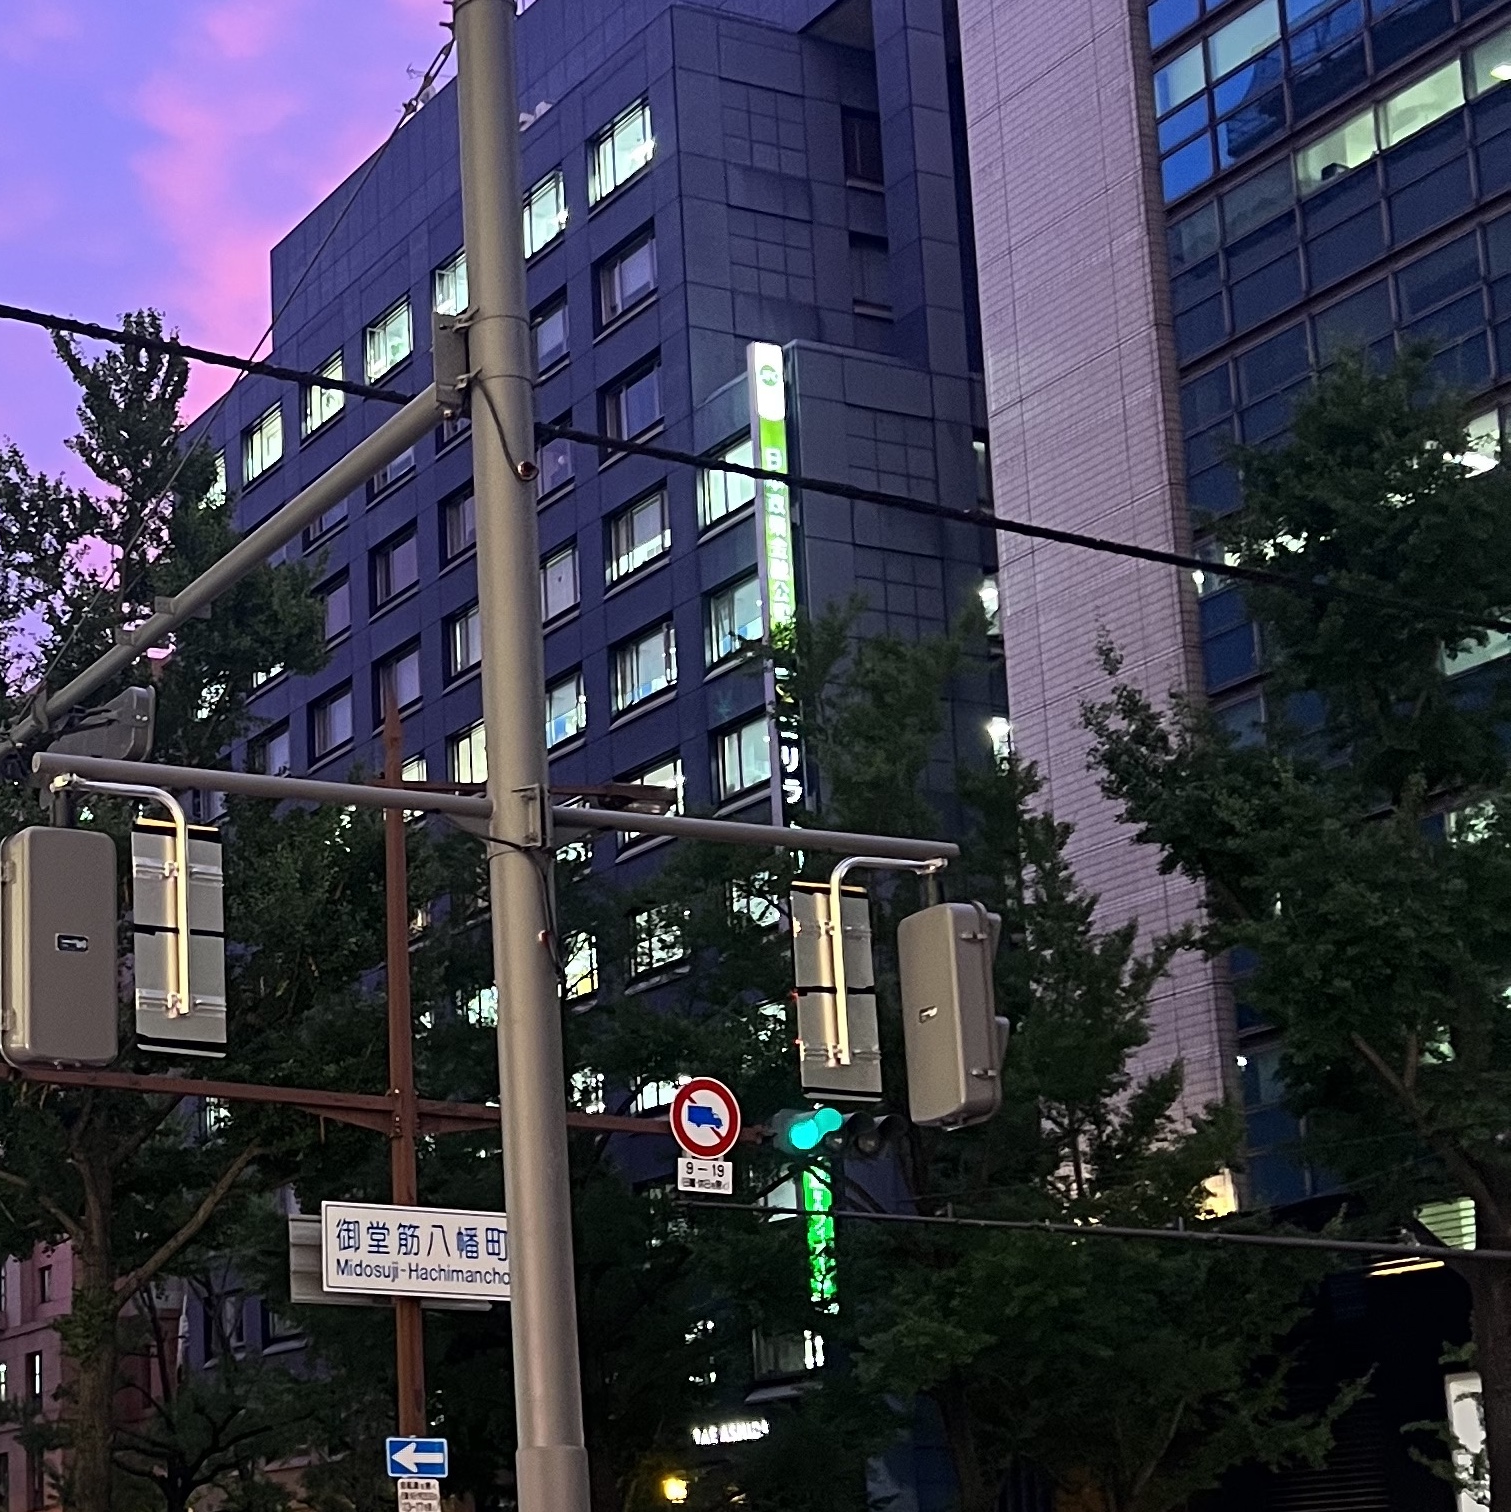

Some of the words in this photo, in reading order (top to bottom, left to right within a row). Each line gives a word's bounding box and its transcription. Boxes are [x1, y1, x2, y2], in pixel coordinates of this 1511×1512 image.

[335, 1218, 508, 1262] 御堂筋八幡町
